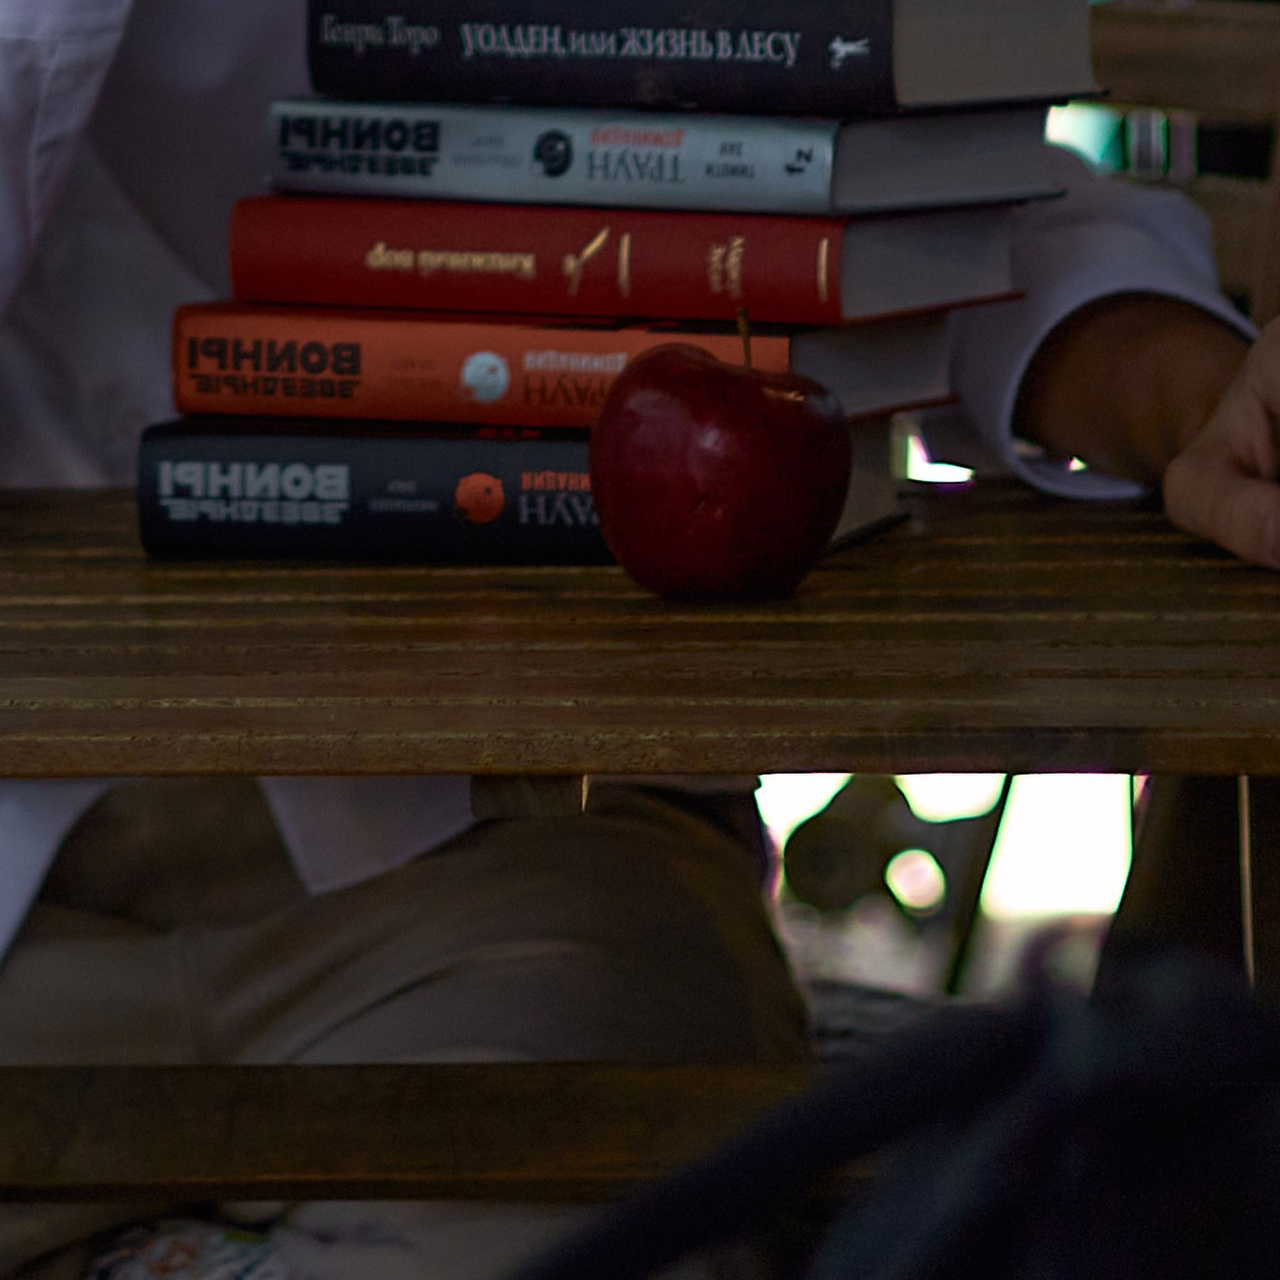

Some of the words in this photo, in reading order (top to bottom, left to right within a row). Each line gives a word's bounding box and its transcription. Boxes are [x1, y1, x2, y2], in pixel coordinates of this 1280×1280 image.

[568, 30, 616, 57] или
[618, 26, 712, 59] ЖИЗНЬ
[715, 32, 732, 59] В
[733, 31, 800, 67] ЛЕСУ
[586, 150, 686, 184] ТРАУН
